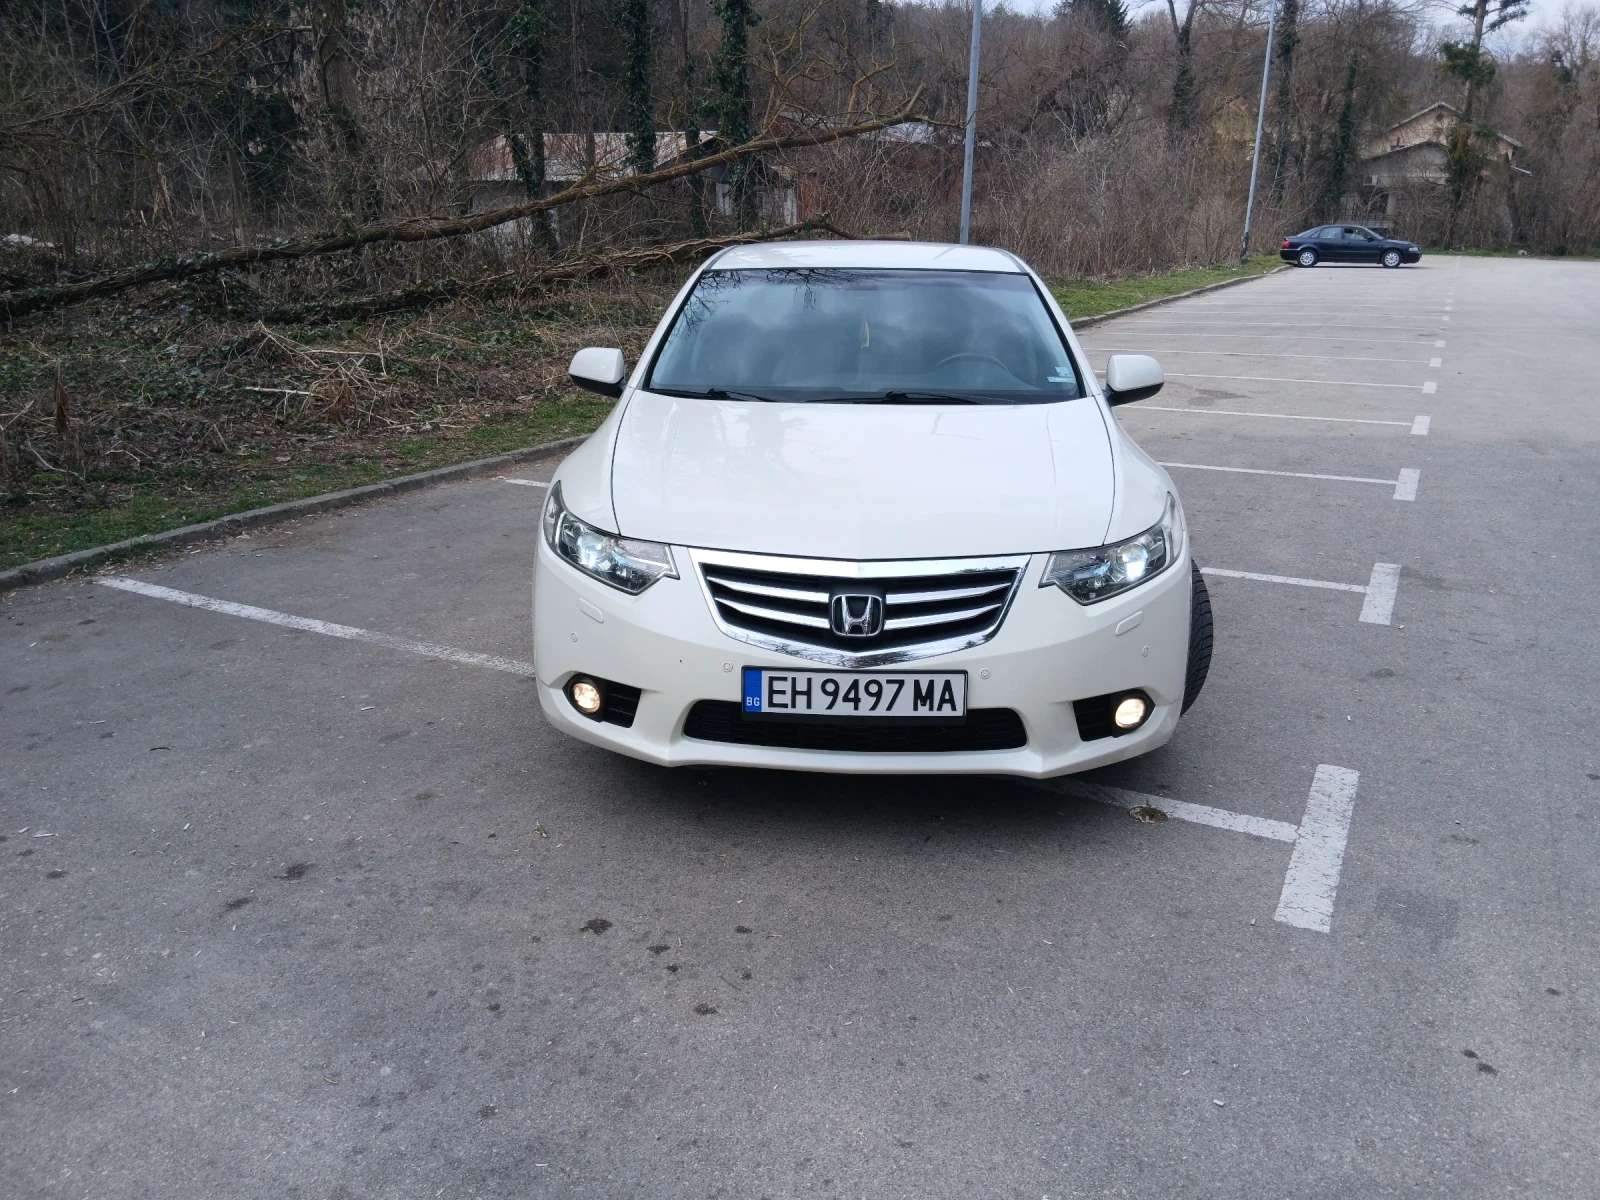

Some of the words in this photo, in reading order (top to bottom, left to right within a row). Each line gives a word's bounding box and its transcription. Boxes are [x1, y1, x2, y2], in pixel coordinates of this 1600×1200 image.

[746, 697, 760, 706] BG
[768, 676, 812, 709] EH
[820, 678, 905, 711] 9497
[913, 679, 957, 711] MA
